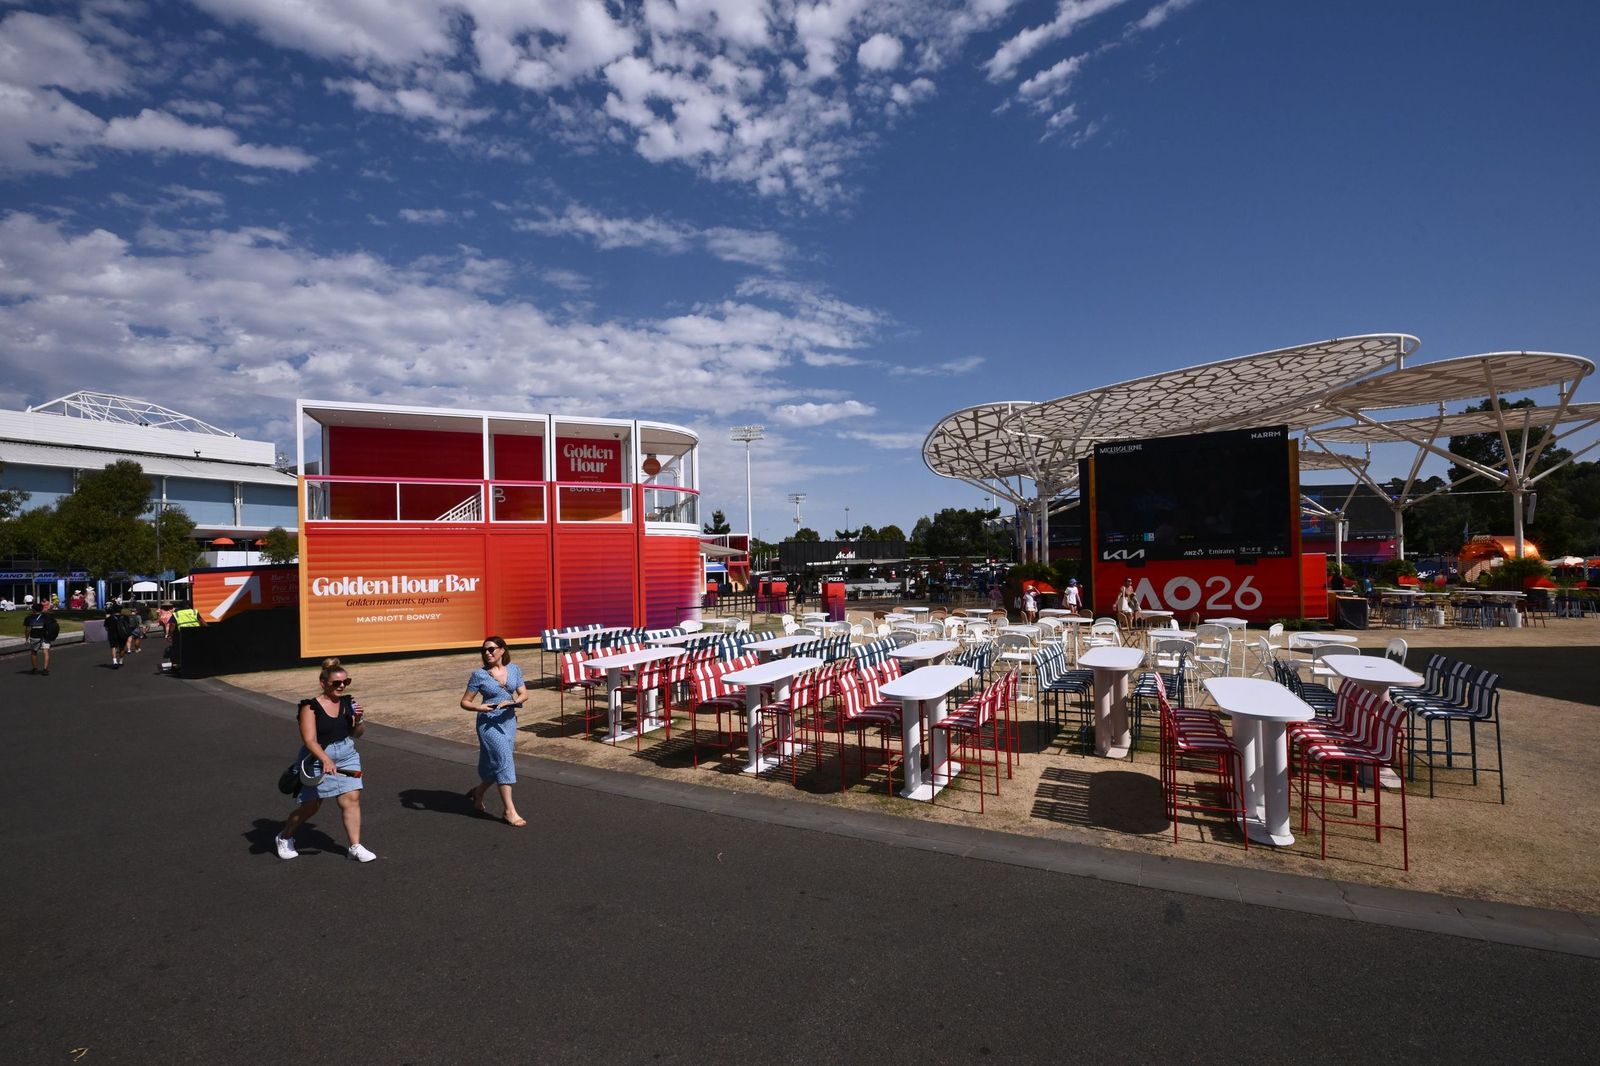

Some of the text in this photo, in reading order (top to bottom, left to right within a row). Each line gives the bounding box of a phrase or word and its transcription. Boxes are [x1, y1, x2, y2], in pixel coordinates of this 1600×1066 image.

[1251, 431, 1281, 439] NARRM
[563, 444, 613, 459] Golden
[570, 457, 608, 473] Hour
[835, 551, 856, 559] Asahi
[1103, 549, 1145, 560] KIA
[312, 576, 388, 596] Golden
[391, 575, 443, 594] Hour
[445, 574, 480, 592] Bar
[1135, 575, 1263, 610] AO26
[346, 598, 376, 607] Golden
[418, 596, 450, 605] upstairs
[356, 613, 442, 623] MARRIOTT BONVOY
